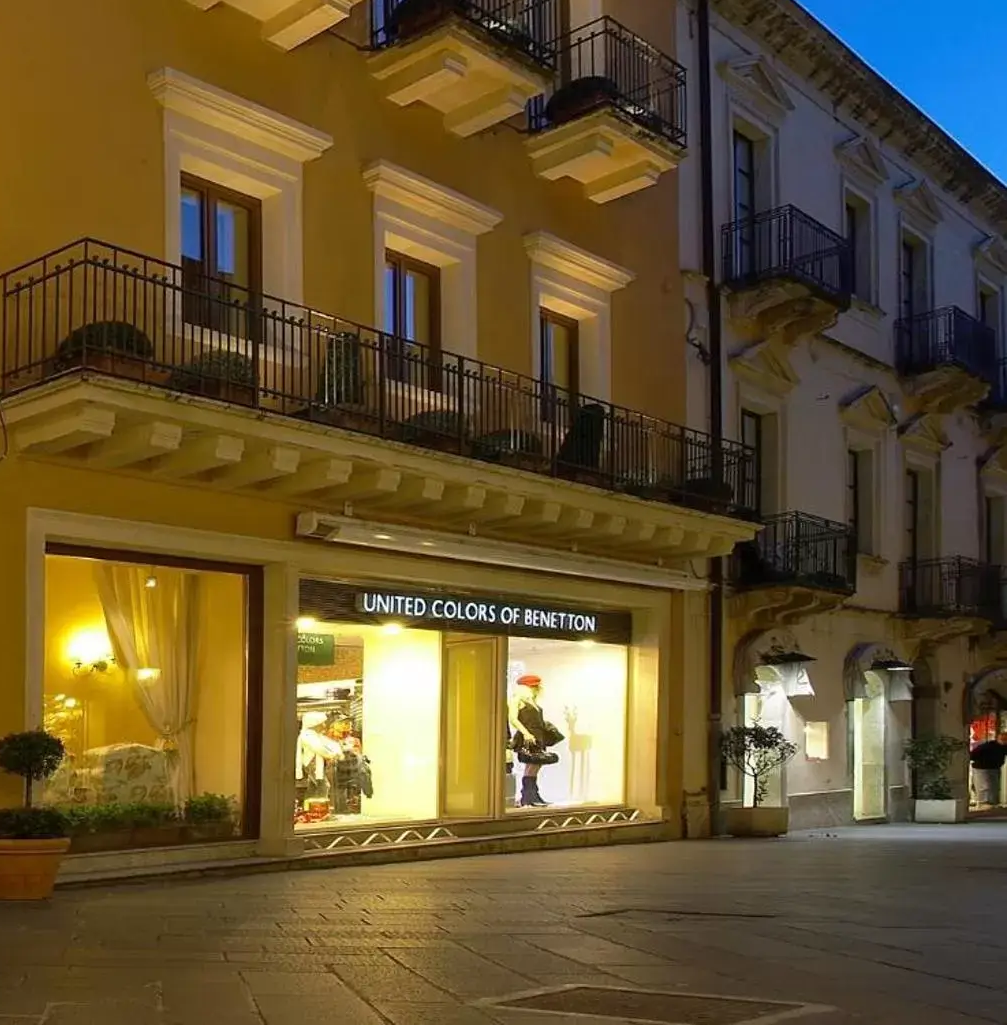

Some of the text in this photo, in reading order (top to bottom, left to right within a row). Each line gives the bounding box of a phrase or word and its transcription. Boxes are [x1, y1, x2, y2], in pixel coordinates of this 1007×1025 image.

[363, 592, 596, 632] UNITED COLORS OF BENETTON
